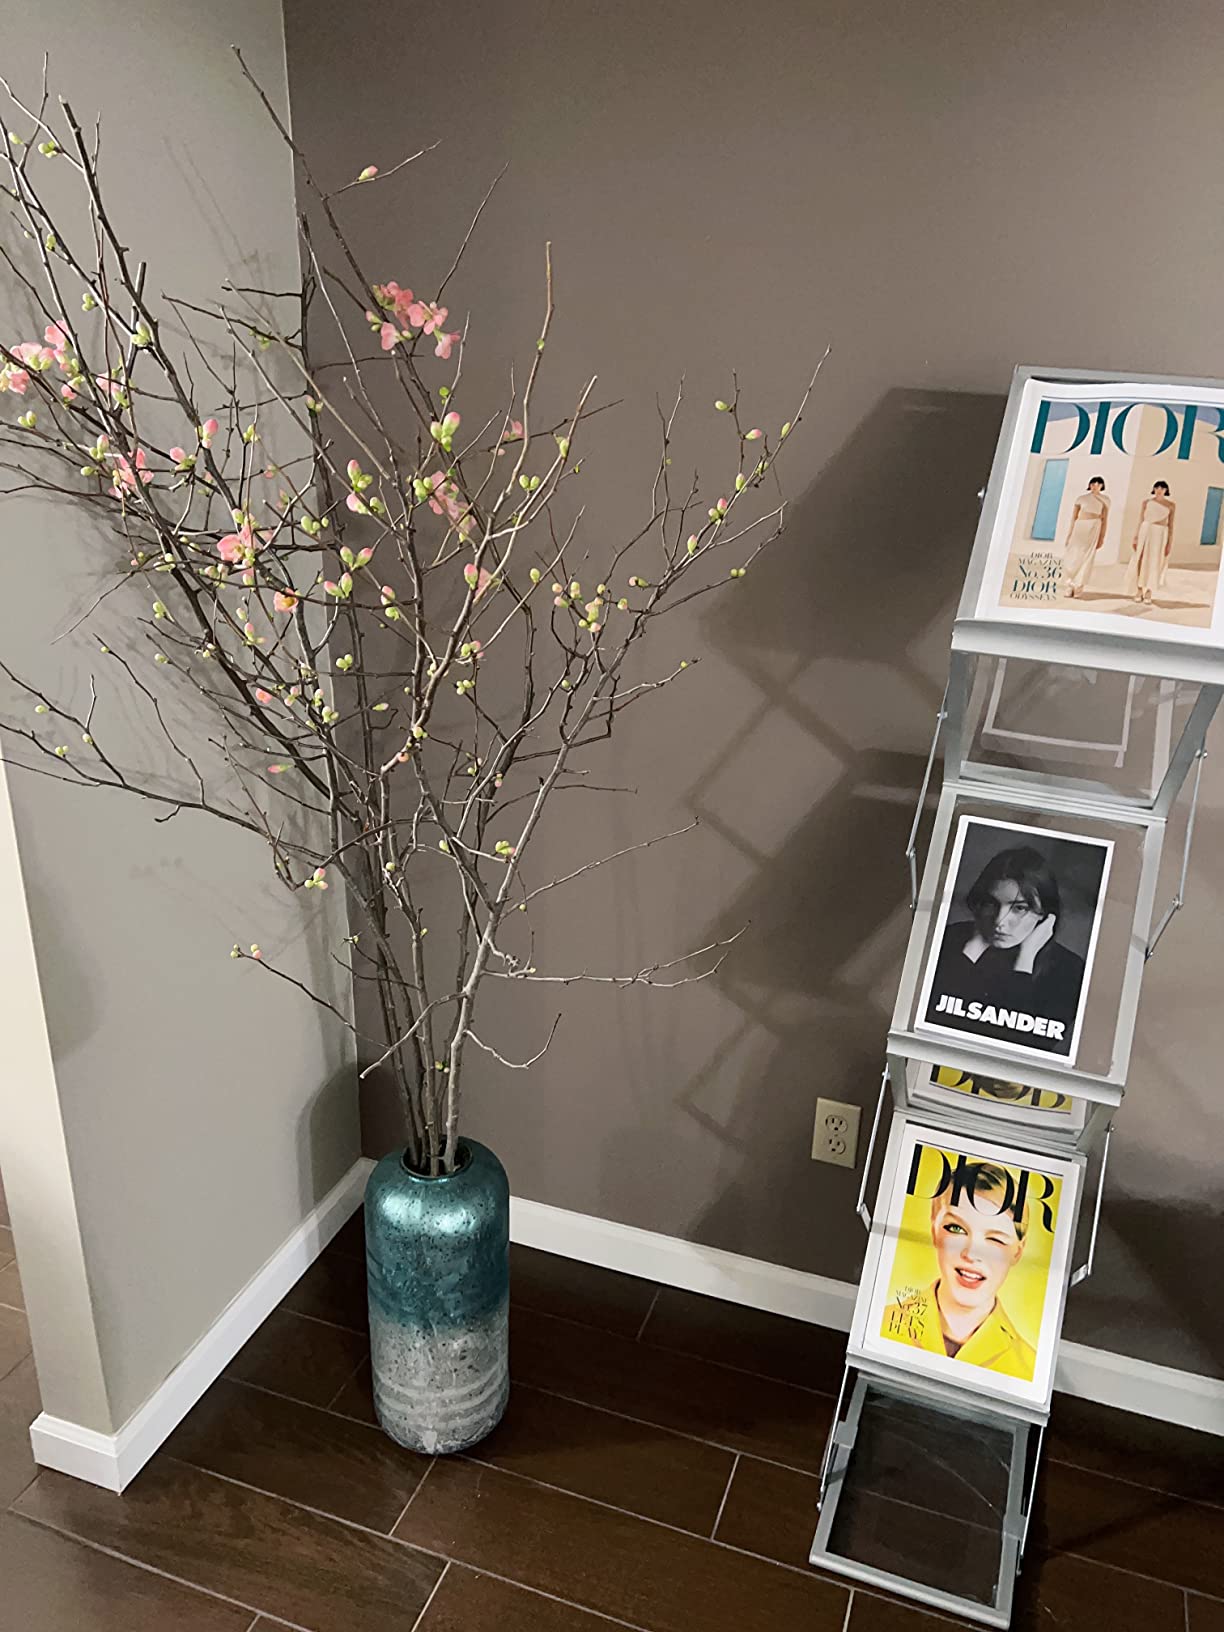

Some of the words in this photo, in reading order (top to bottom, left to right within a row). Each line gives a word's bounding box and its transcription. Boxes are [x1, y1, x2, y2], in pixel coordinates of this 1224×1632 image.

[1030, 399, 1224, 465] DIOR
[1013, 580, 1056, 593] DIOR
[935, 994, 966, 1018] JIL
[966, 1001, 1066, 1041] SANDER
[905, 1143, 1055, 1233] DIOR
